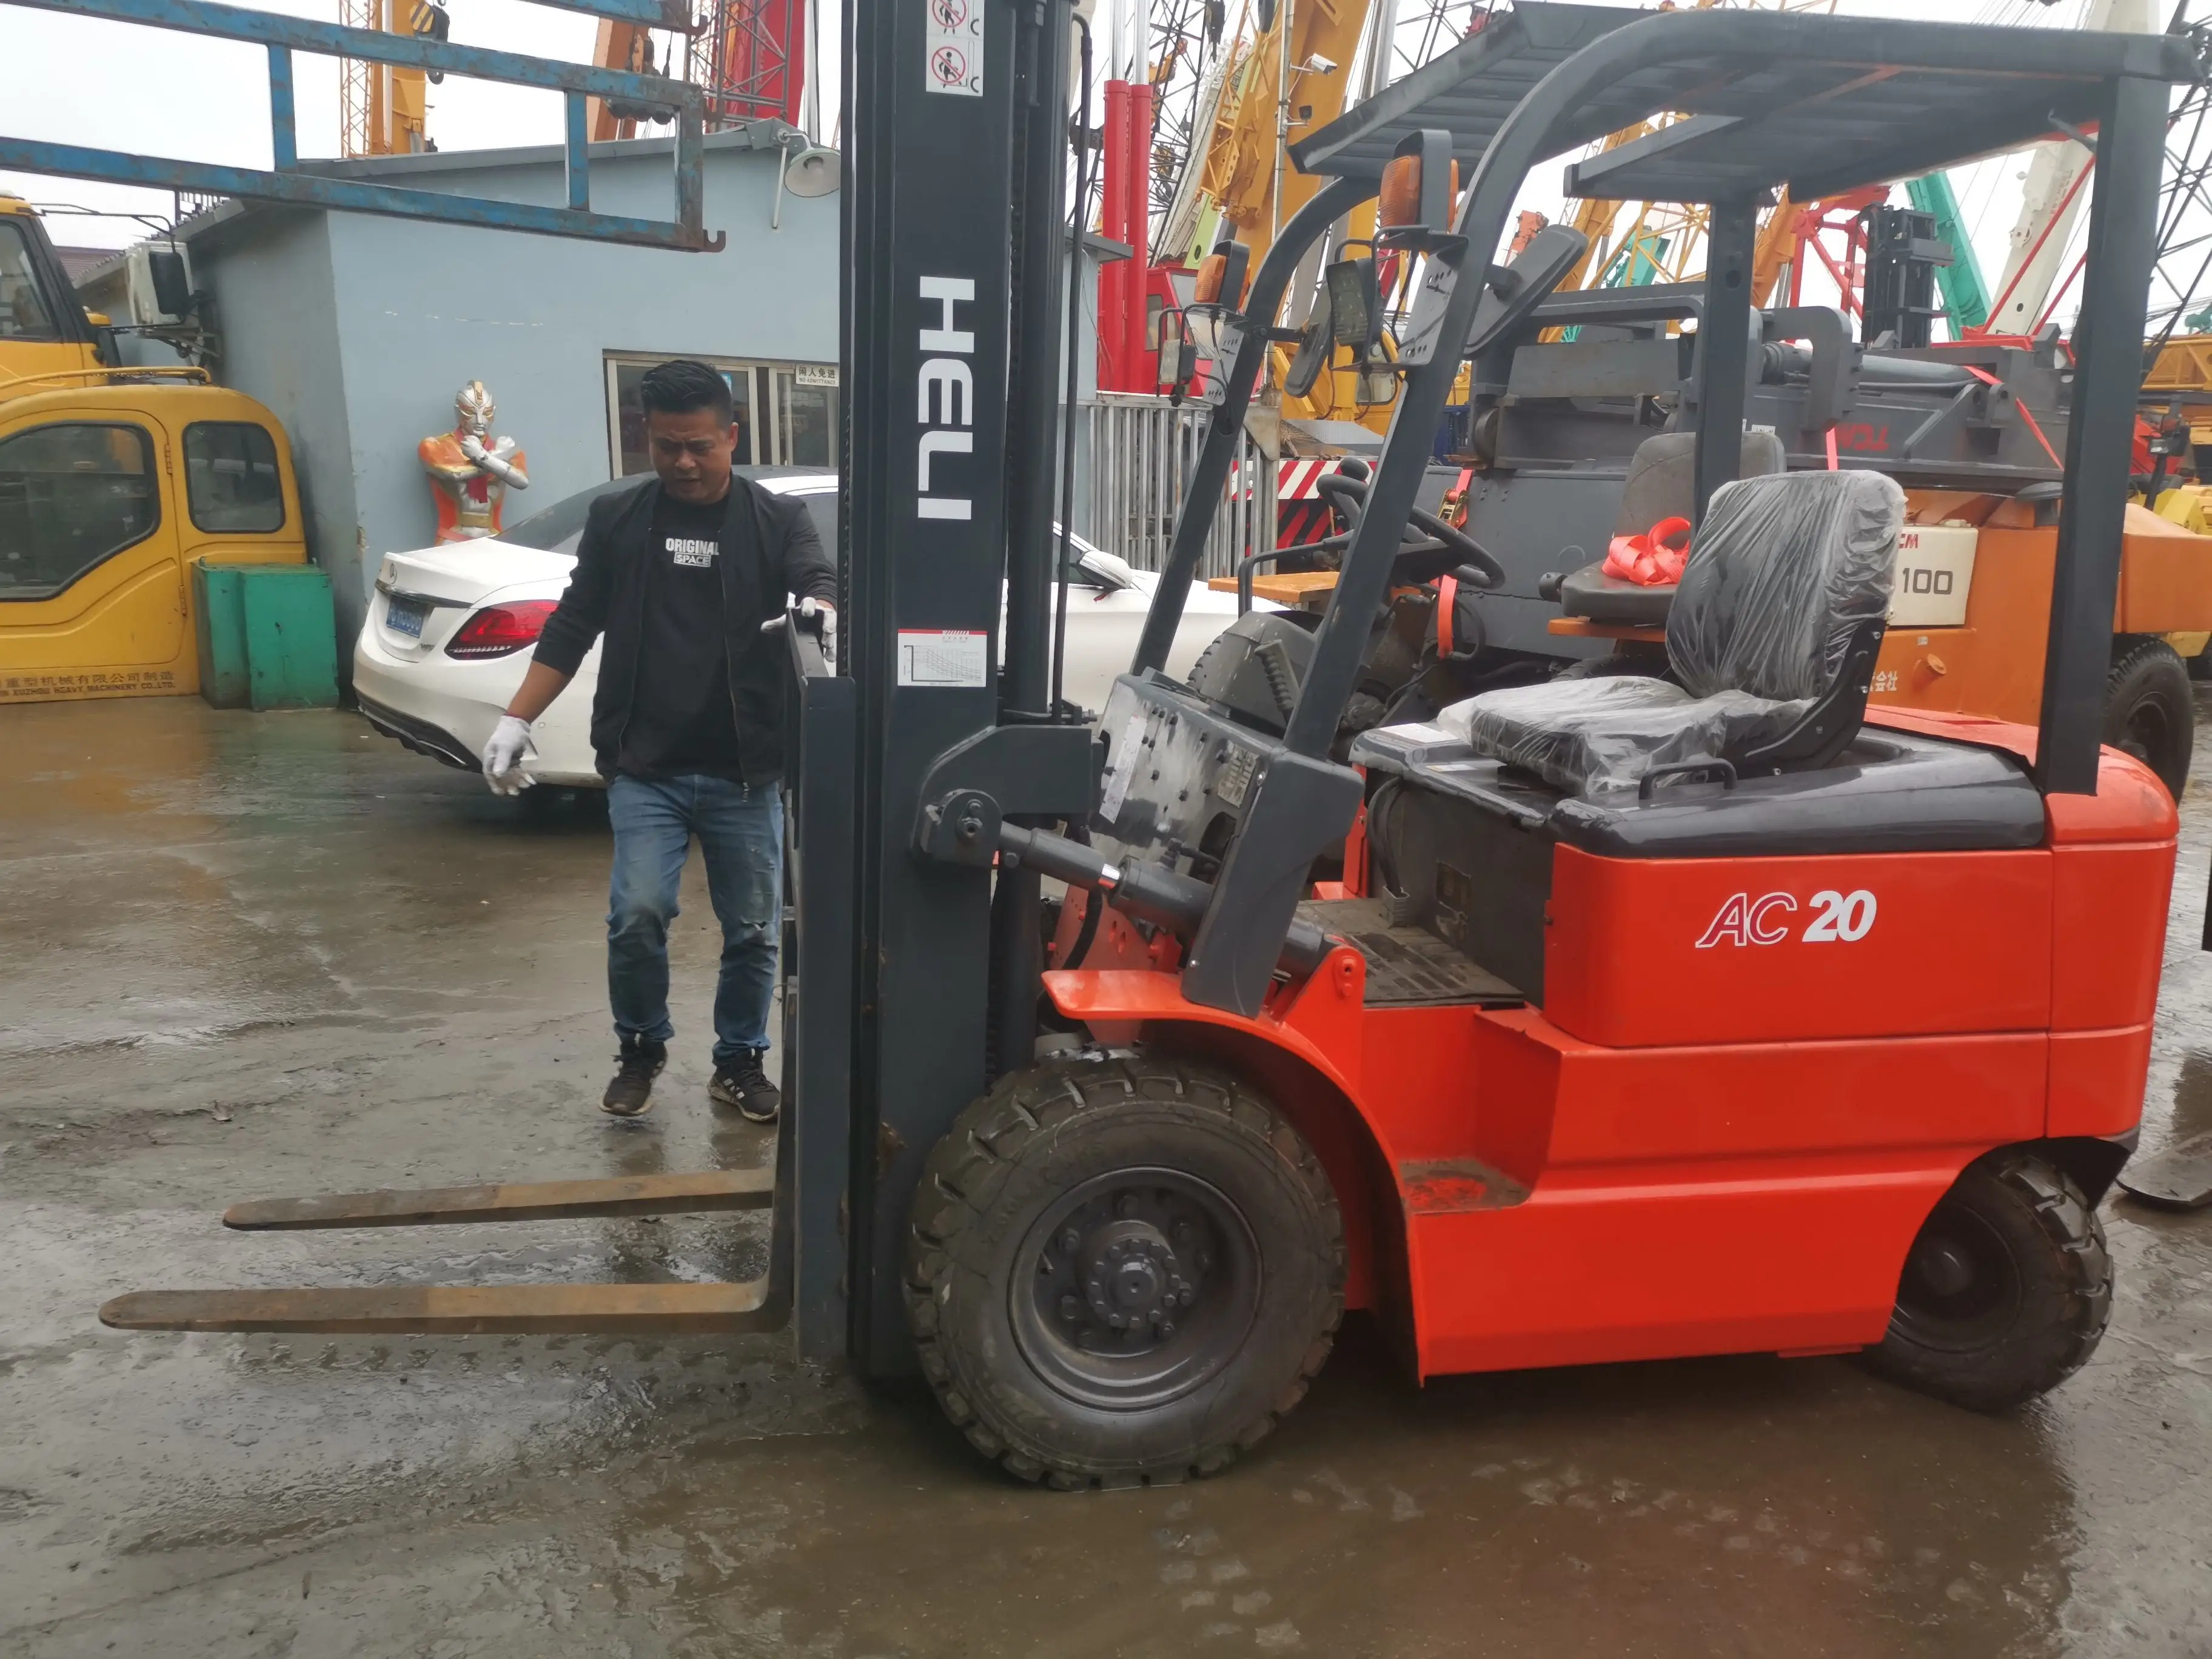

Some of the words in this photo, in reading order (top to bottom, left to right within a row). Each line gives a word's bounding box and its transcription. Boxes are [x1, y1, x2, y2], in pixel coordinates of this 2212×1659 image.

[799, 366, 836, 379] 闲人免进
[918, 276, 974, 520] HELI
[665, 538, 719, 555] ORIGINAL
[675, 554, 709, 565] SPACE
[1903, 568, 1953, 595] 100
[0, 671, 175, 689] 重型机械有限公司制造
[1869, 671, 1898, 691] 会社
[1695, 892, 1797, 947] AC
[1802, 890, 1877, 942] 20
